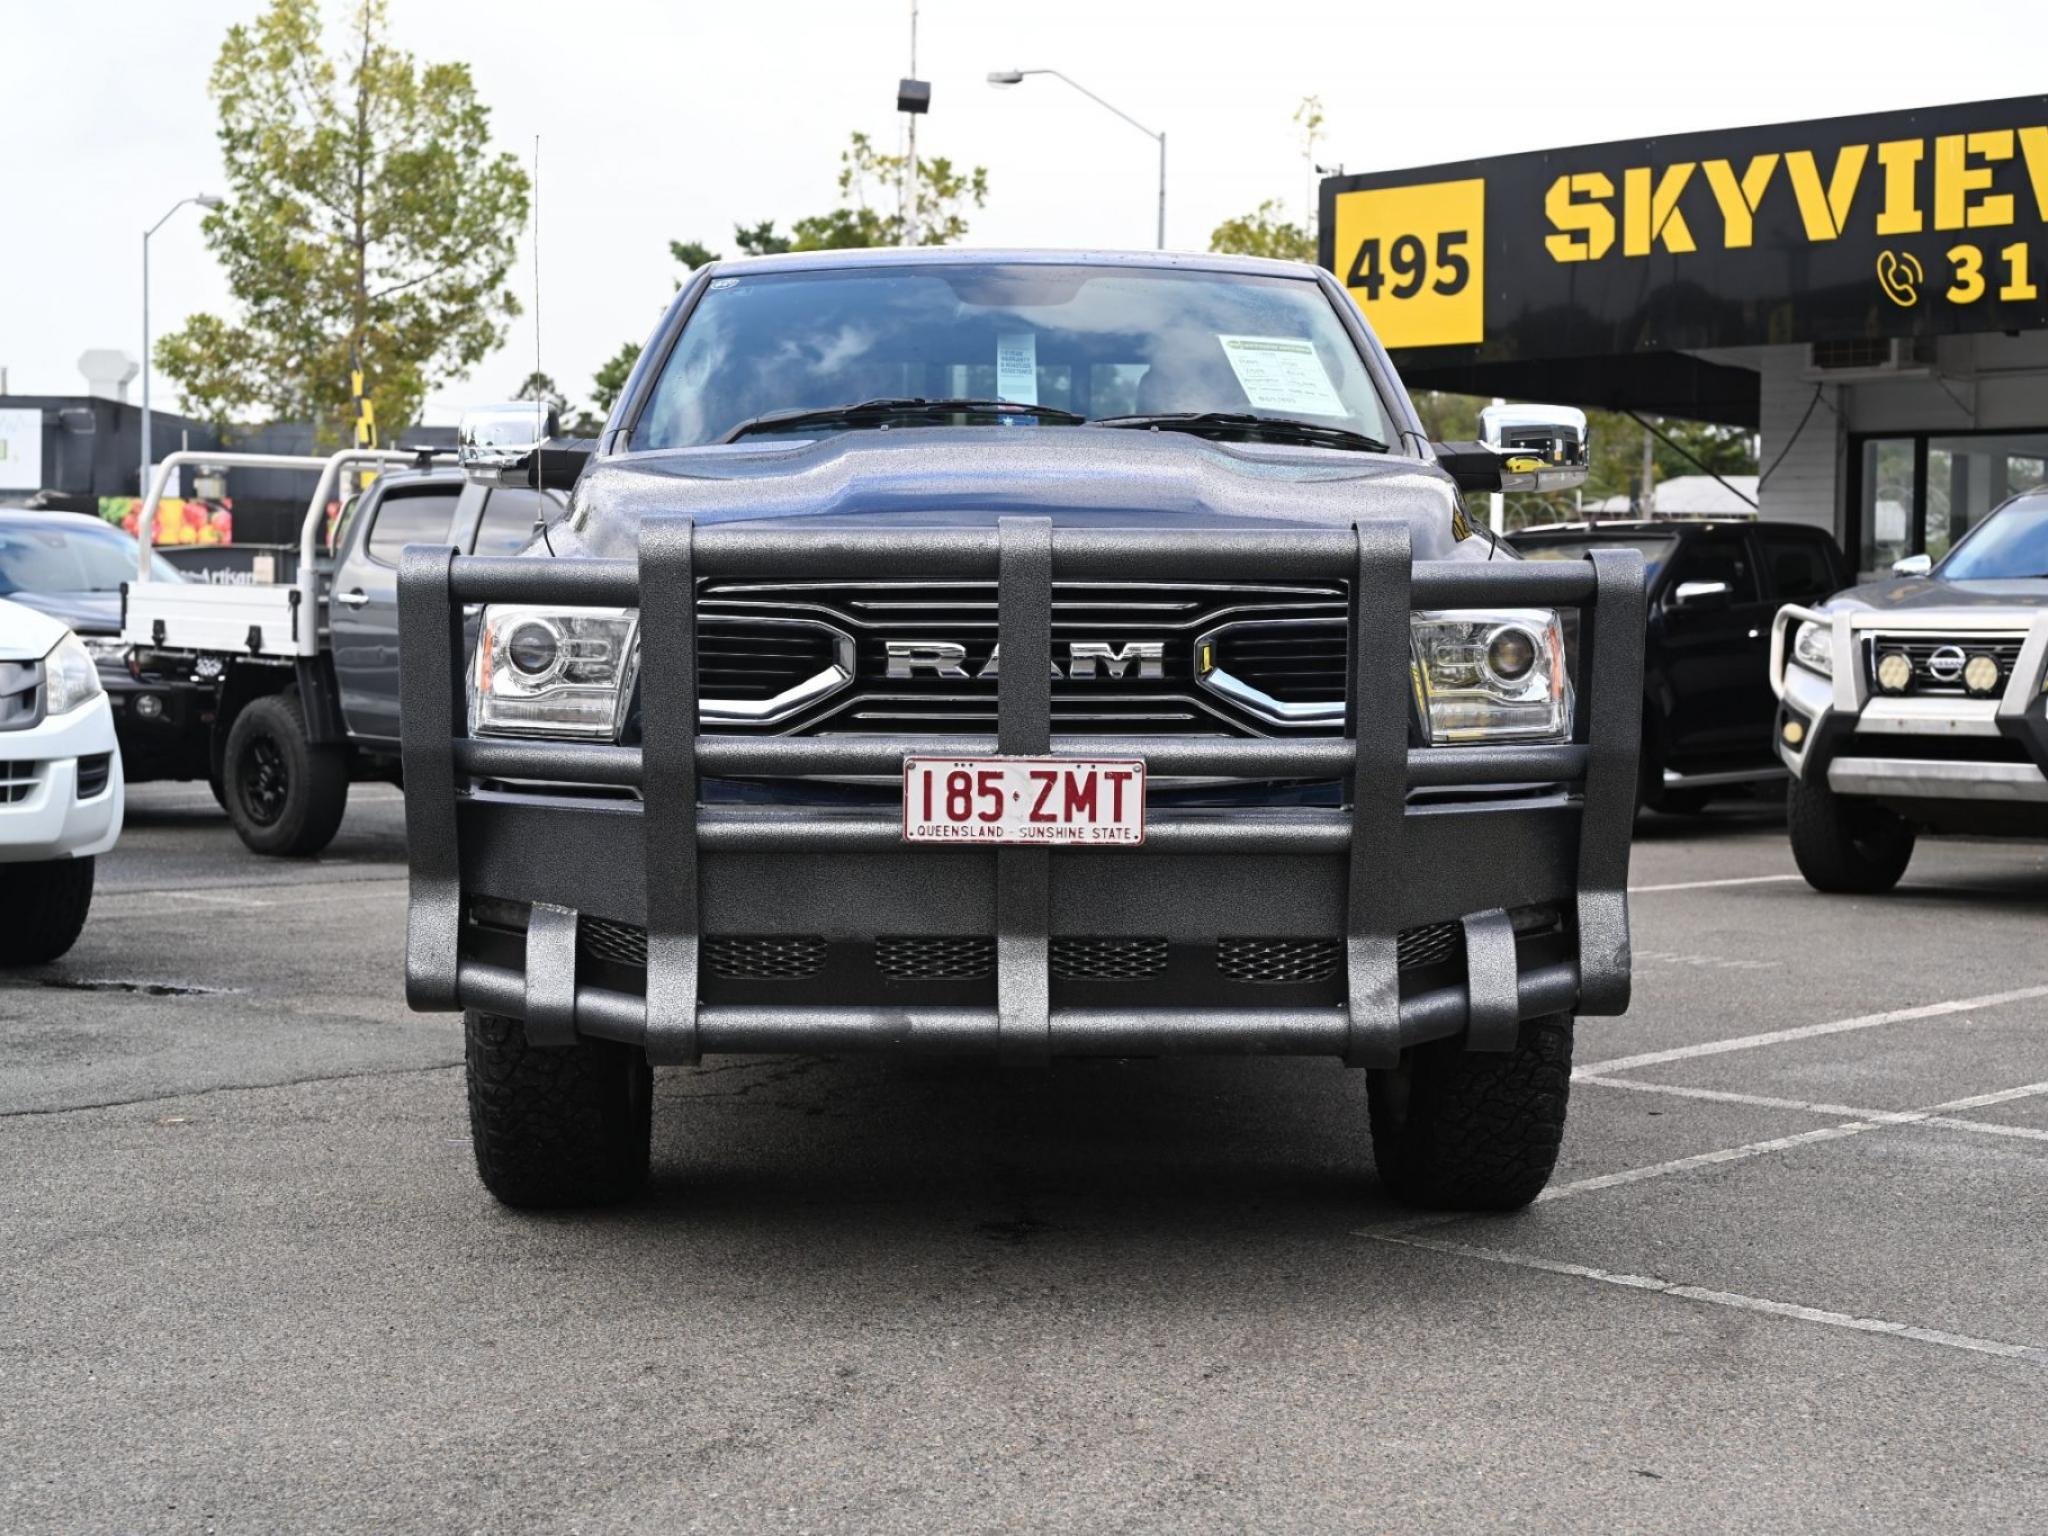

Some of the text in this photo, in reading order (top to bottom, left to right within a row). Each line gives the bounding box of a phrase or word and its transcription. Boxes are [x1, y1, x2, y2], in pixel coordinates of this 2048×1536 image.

[1545, 126, 2048, 262] SKYVIE
[1346, 230, 1470, 301] 495
[1946, 242, 2037, 304] 31
[923, 769, 1133, 823] 185 ZMT
[916, 825, 1004, 838] QUEENSLAND
[1018, 827, 1085, 839] SUNSHINE
[1091, 828, 1131, 840] STATE
